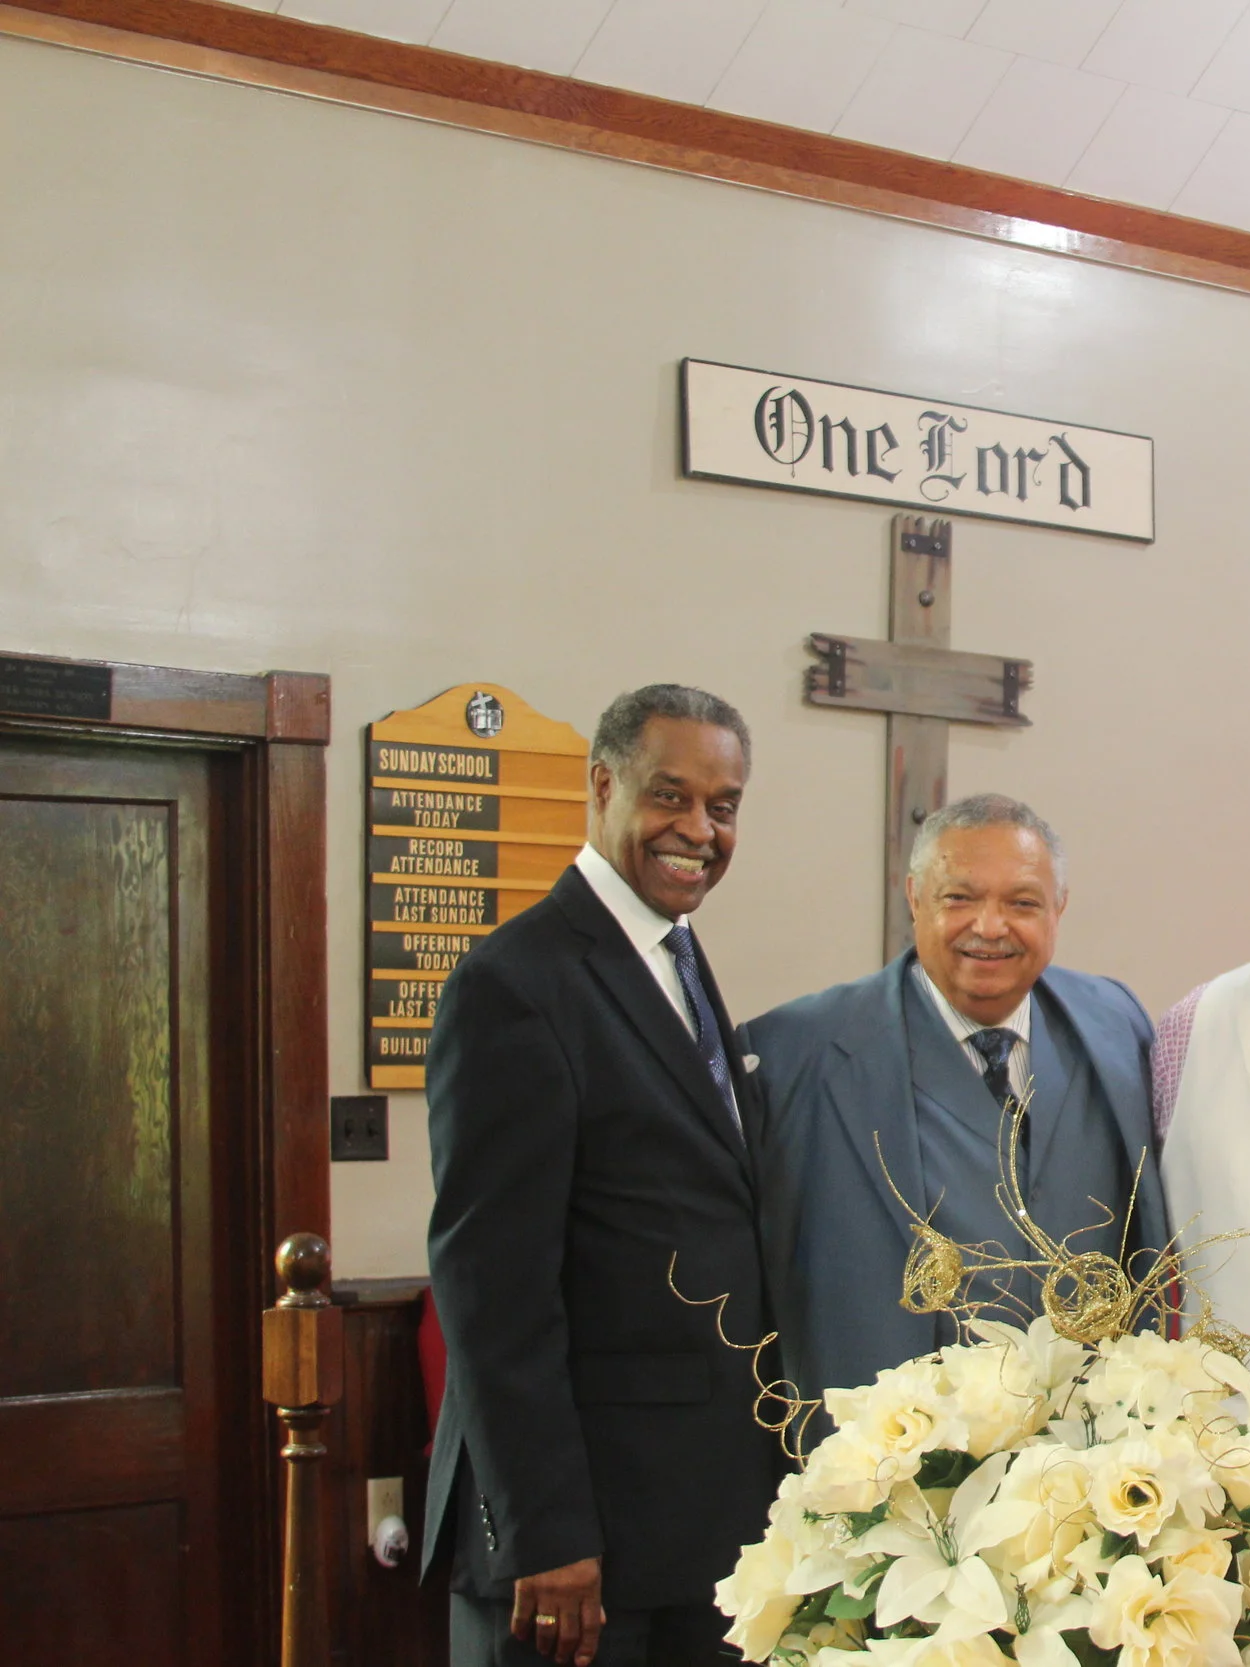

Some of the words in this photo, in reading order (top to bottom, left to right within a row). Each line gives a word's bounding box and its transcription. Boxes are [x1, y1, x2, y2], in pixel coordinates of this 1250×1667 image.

[754, 385, 902, 483] One
[917, 410, 1092, 512] Lord
[379, 748, 436, 773] SUNDAY
[438, 753, 493, 778] SCHOOL
[391, 791, 483, 812] ATTENDANCE
[413, 810, 460, 828] TODAY
[408, 839, 464, 857] RECORD
[390, 856, 480, 876] ATTENDANCE
[394, 887, 485, 907] ATTENDANCE
[394, 905, 426, 922] LAST
[431, 906, 485, 924] SUNDAY
[403, 934, 471, 953] OFFERING
[416, 953, 460, 970] TODAY
[389, 1000, 423, 1017] LAST
[380, 1037, 431, 1056] BUILDI
